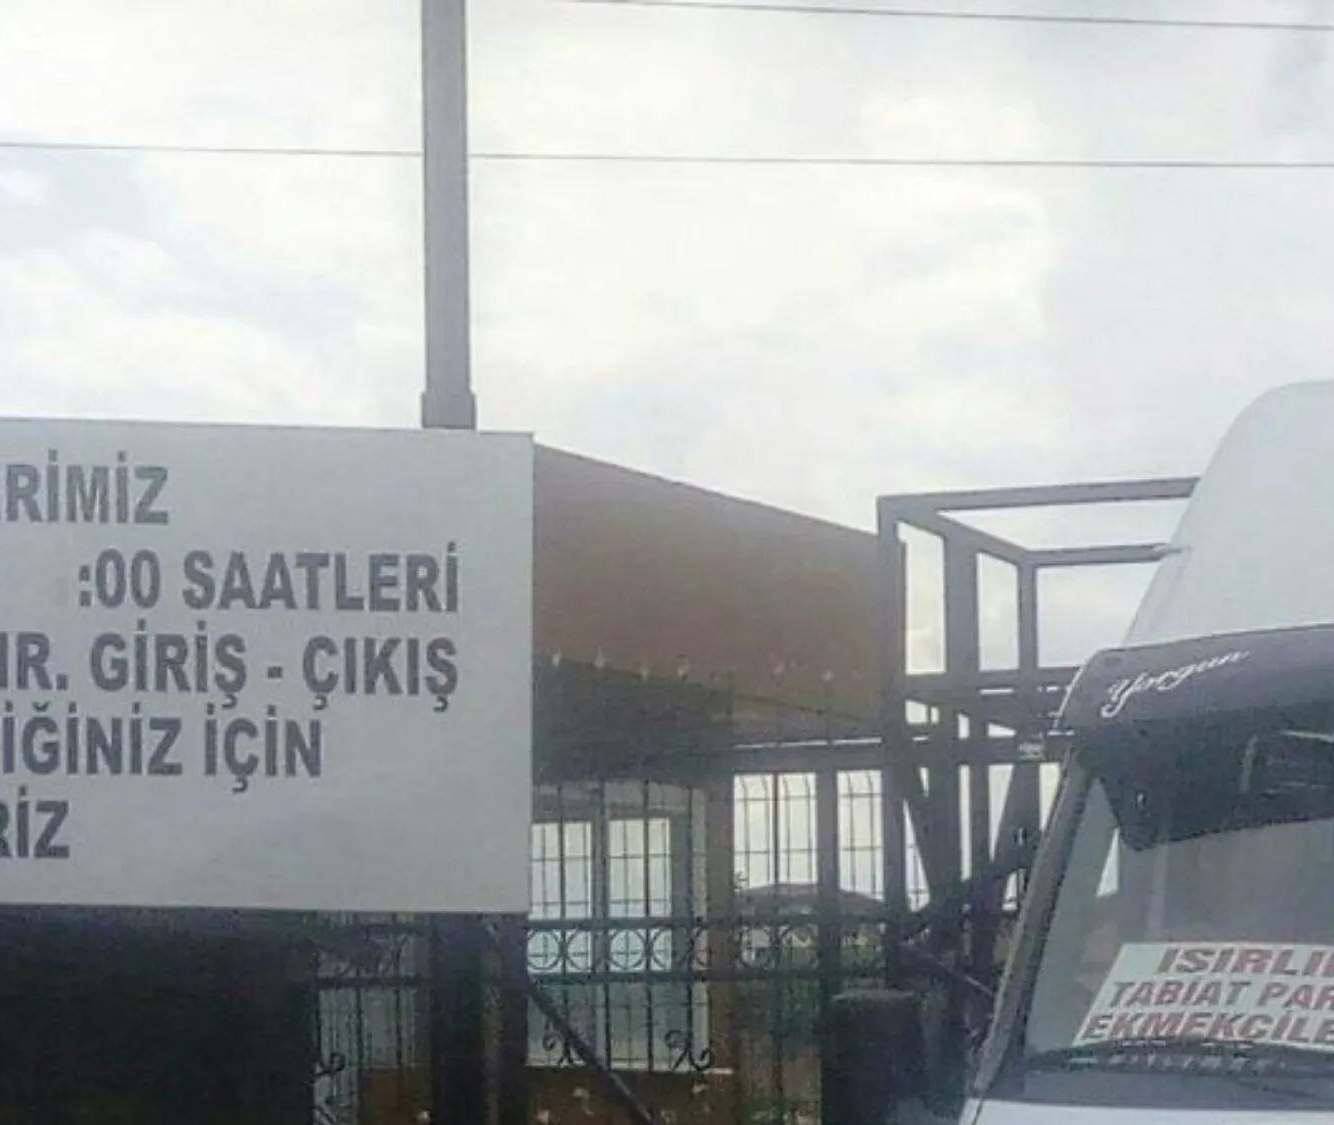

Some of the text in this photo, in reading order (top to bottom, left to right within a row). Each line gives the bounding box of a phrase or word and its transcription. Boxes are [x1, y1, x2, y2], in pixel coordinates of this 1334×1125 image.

[182, 541, 458, 613] SAATLERİ
[89, 619, 247, 708] GİRİŞ
[302, 636, 458, 712] ÇIKIŞ
[203, 703, 322, 793] İÇİN
